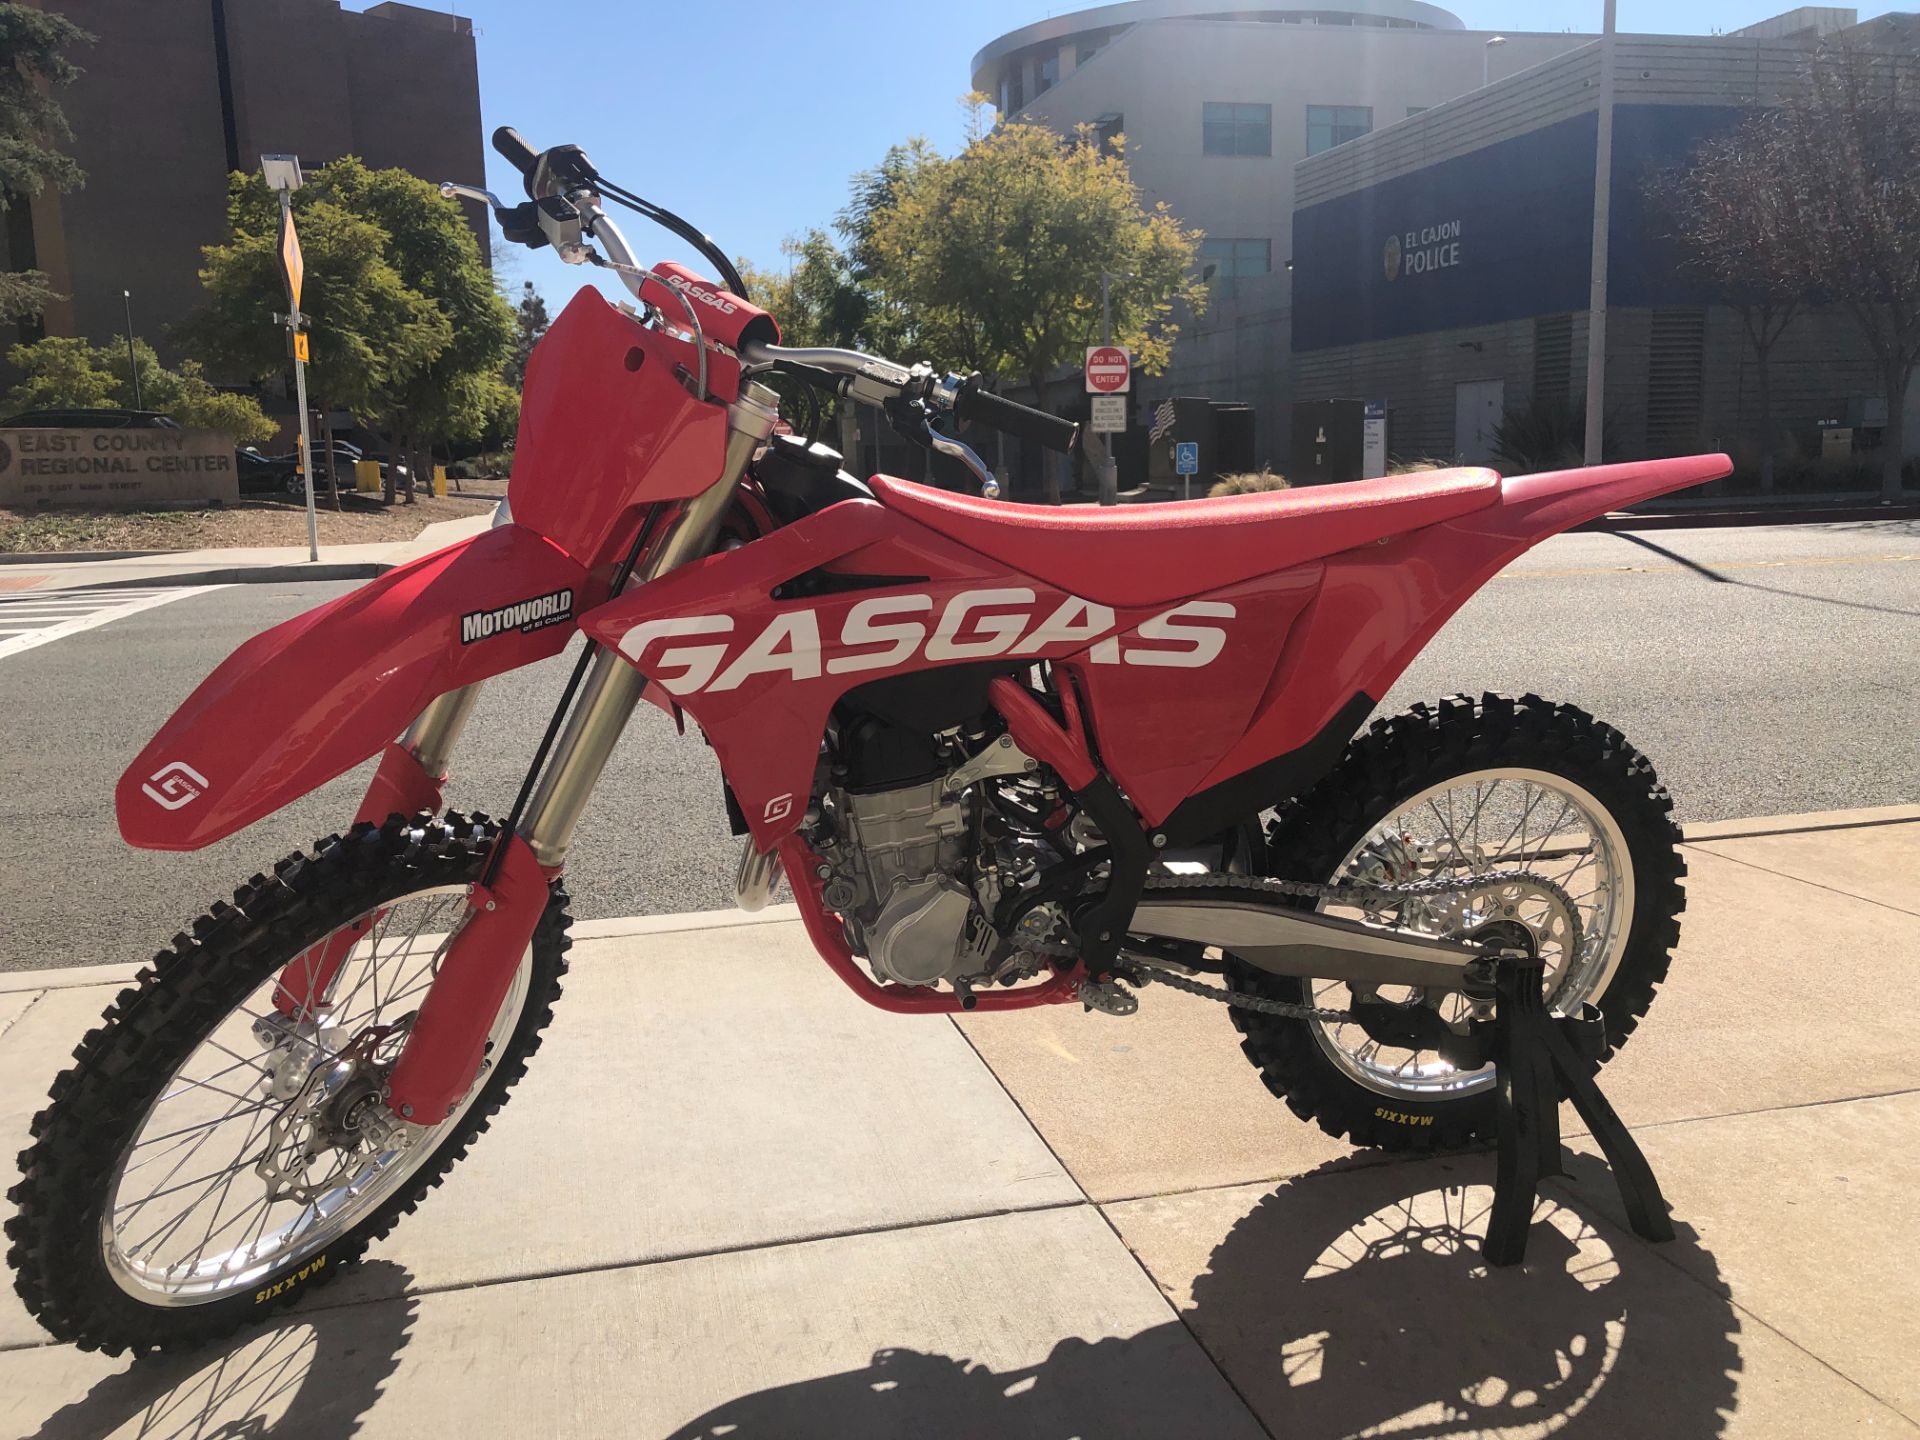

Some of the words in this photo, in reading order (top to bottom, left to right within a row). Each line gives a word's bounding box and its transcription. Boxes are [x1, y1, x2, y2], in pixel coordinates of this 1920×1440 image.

[1405, 232, 1418, 249] EL
[1421, 219, 1461, 245] CAJON
[1405, 242, 1460, 275] POLICE
[667, 274, 738, 315] GASGAS
[1093, 355, 1104, 364] DO
[1108, 355, 1123, 364] NOT
[1095, 375, 1120, 384] ENTER
[18, 434, 81, 453] EAST
[20, 456, 138, 476] REGIONAL
[145, 454, 230, 473] CENTER
[523, 623, 532, 632] of
[544, 612, 571, 626] Cajon
[617, 587, 1237, 696] GASGAS
[1375, 1107, 1434, 1126] MAXXIS
[255, 1254, 326, 1305] MAXXIS
